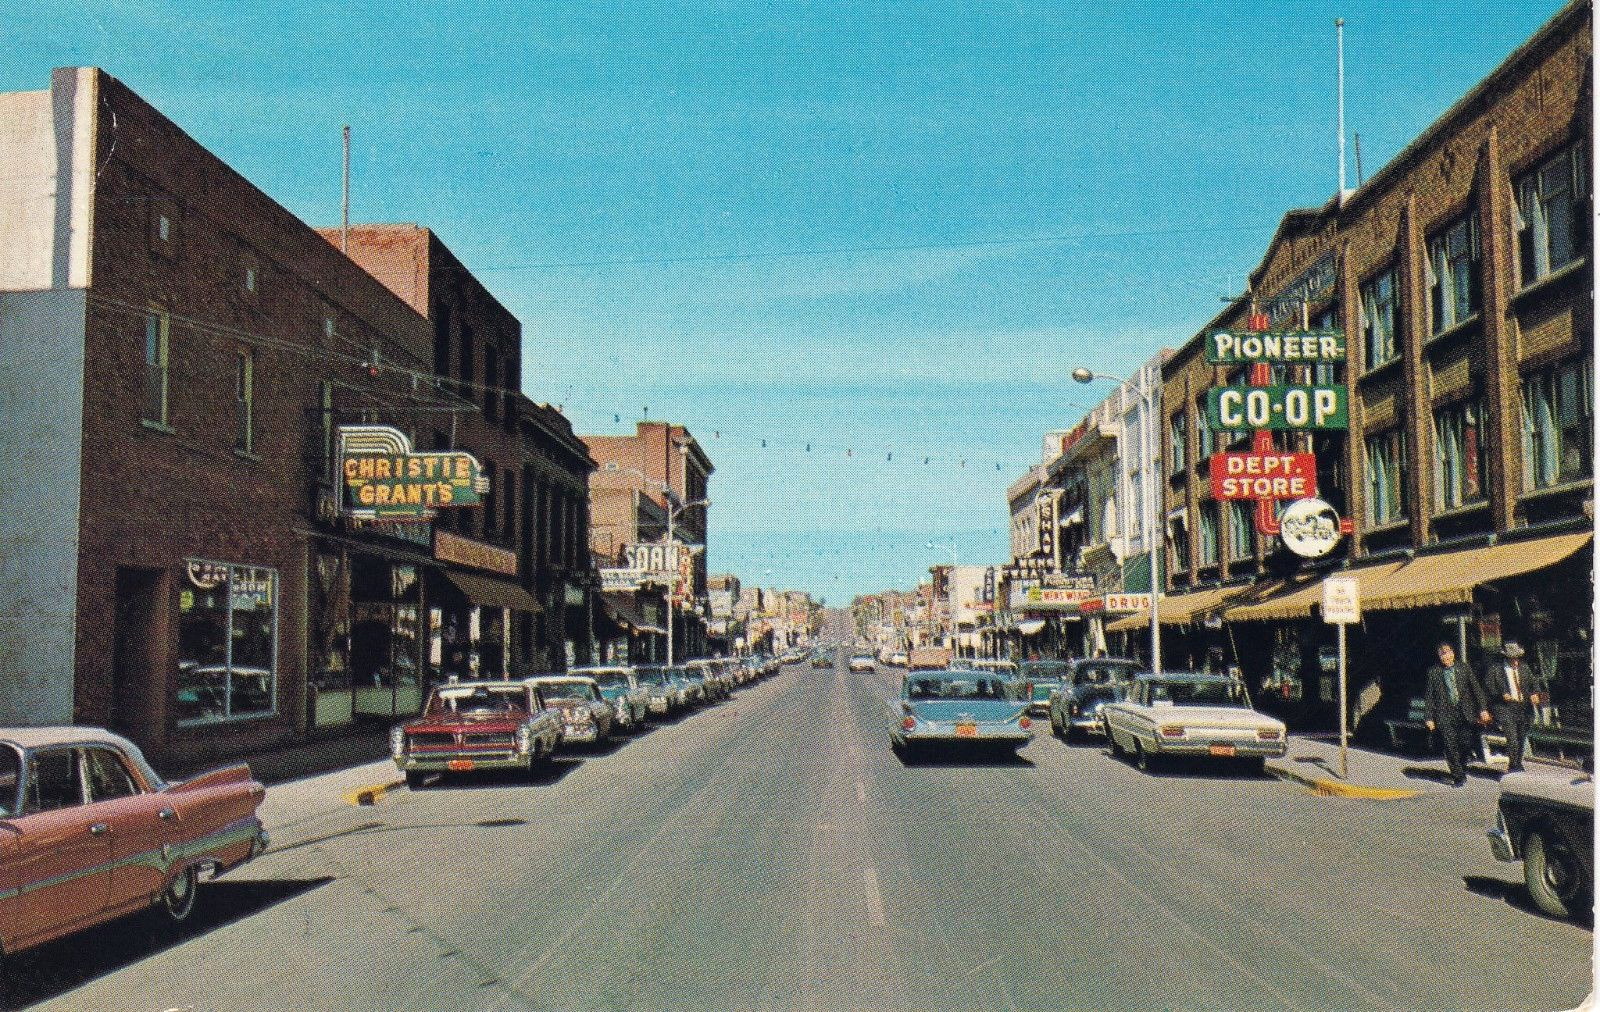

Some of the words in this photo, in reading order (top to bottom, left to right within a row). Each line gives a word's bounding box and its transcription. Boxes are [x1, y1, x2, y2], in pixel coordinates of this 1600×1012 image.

[1214, 333, 1341, 358] PIONEER
[344, 458, 471, 479] CHRISTIE
[1227, 456, 1302, 475] DEPT.
[1222, 477, 1306, 497] STORE
[1109, 597, 1150, 609] DRUG
